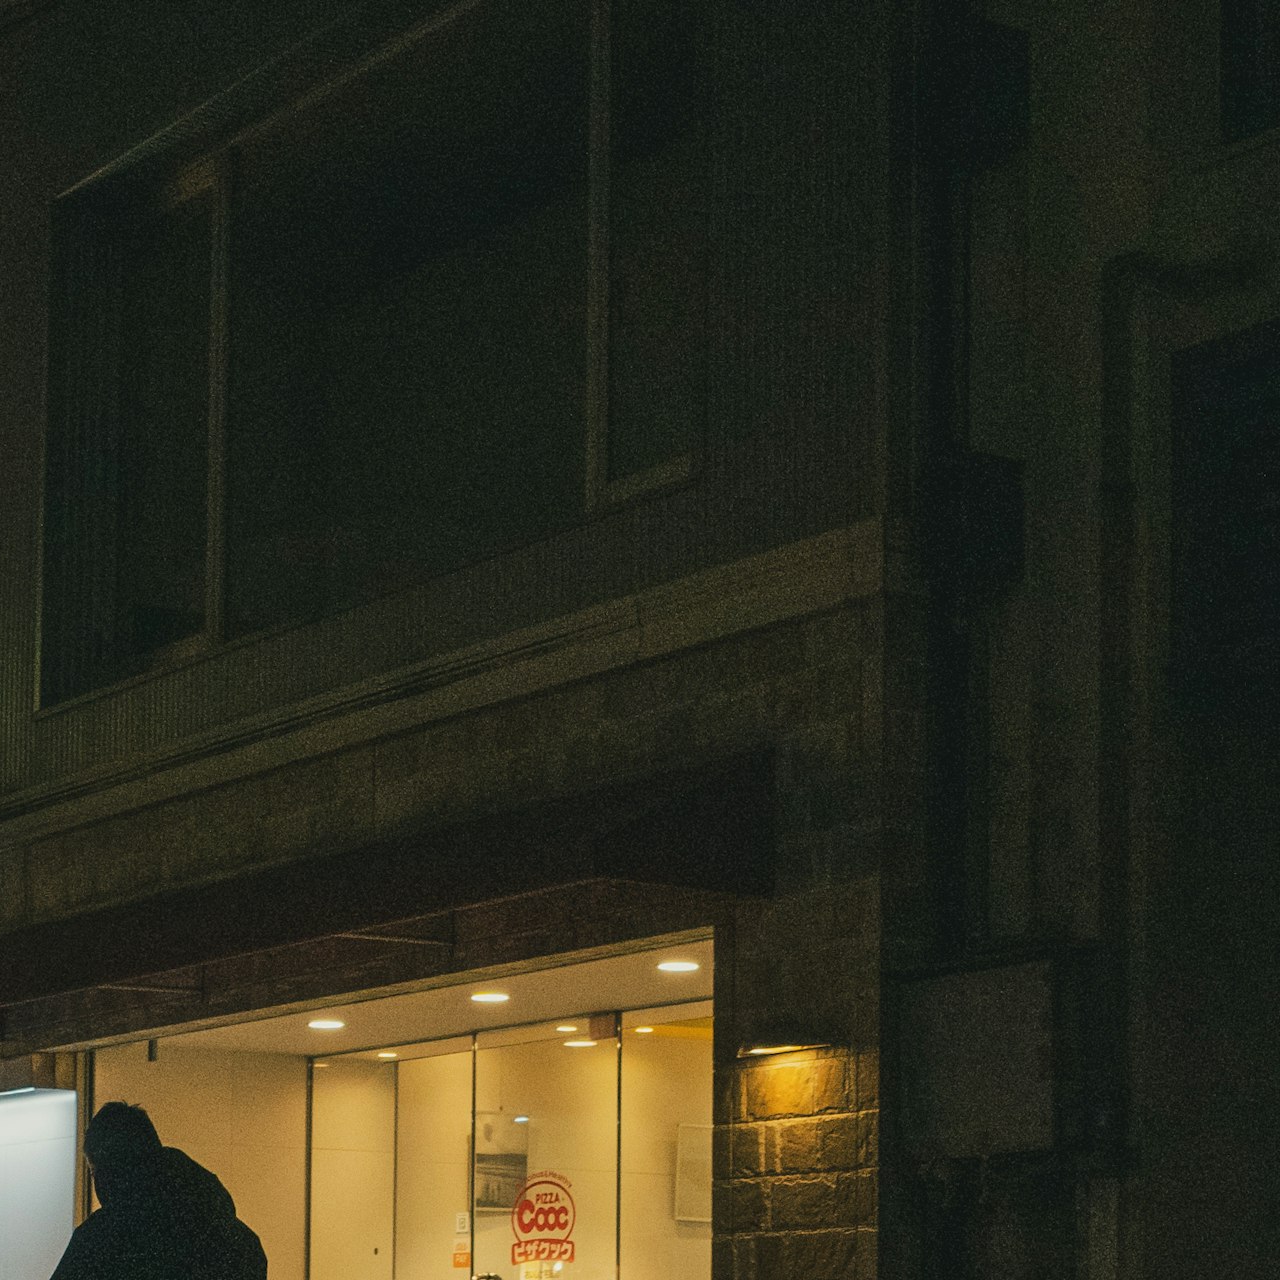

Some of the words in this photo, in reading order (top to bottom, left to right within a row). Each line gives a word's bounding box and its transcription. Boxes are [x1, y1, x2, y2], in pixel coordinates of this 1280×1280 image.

[535, 1192, 560, 1204] PIZZA
[514, 1242, 573, 1262] ピザクック
